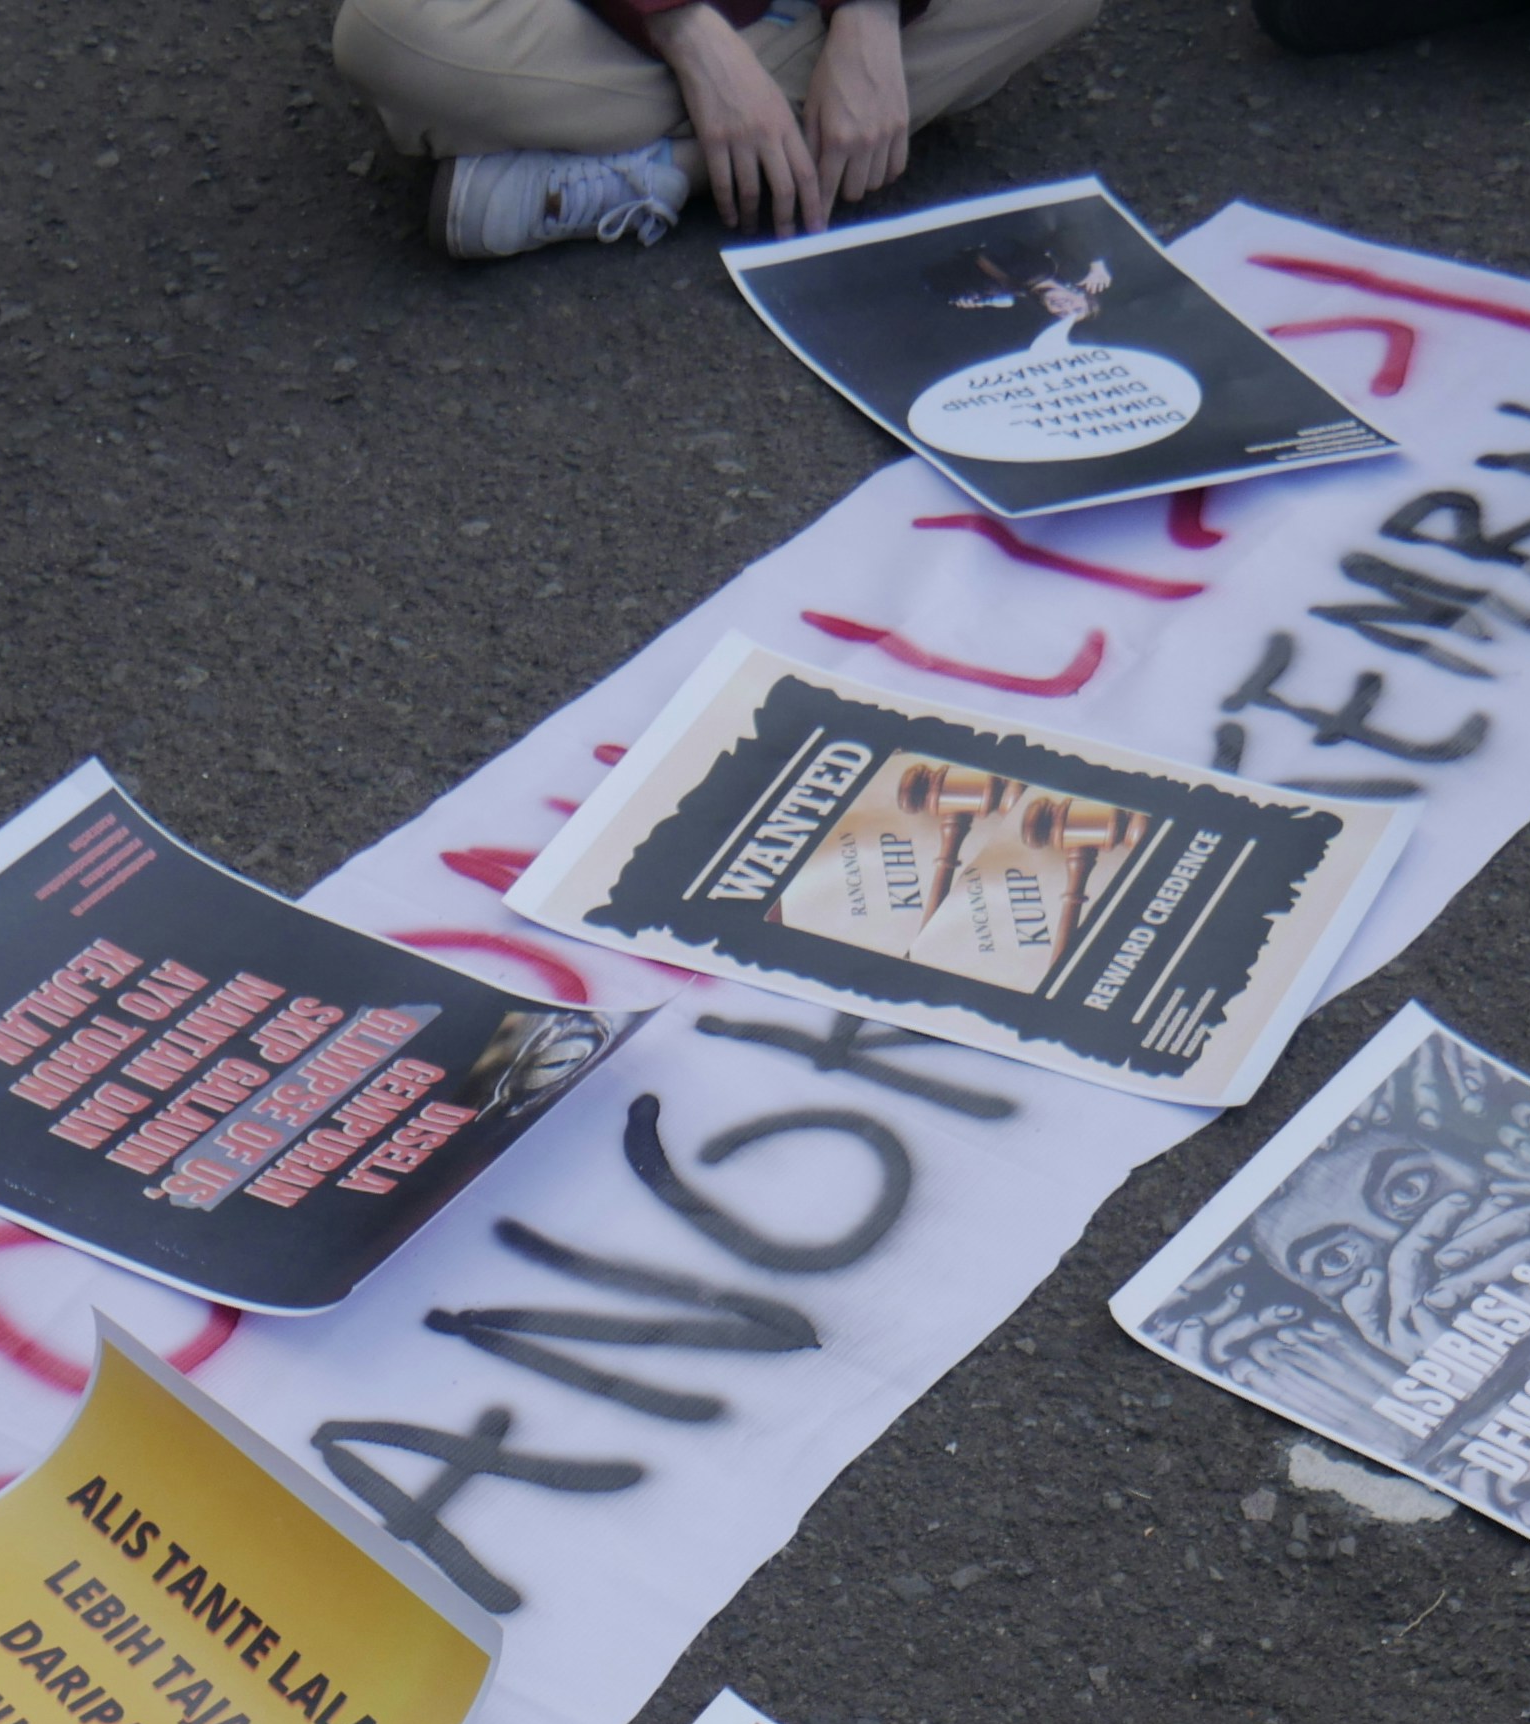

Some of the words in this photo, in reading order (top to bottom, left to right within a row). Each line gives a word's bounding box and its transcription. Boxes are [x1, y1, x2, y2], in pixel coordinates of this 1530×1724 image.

[938, 384, 1037, 414] RKUHP
[965, 347, 1114, 391] DIMANA???
[1038, 364, 1133, 394] DRAFT
[706, 740, 873, 900] WANTED
[837, 830, 869, 916] RANCANGAN
[879, 829, 925, 911] KUHP
[1004, 865, 1053, 947] KUHP
[1082, 925, 1156, 1011] REWARD
[1141, 829, 1222, 925] CREDENCE
[121, 960, 209, 1022] AYO
[126, 973, 287, 1092] MANTAN
[253, 996, 346, 1065] SKIP
[14, 1015, 148, 1110] TURUN
[248, 1006, 423, 1132] GLIMPSE
[55, 1082, 153, 1150] DAN
[108, 1056, 272, 1175] GALAUIN
[205, 1117, 289, 1169] OF
[249, 1058, 447, 1208] GEMPURAN
[340, 1101, 479, 1195] DISELA
[42, 1558, 166, 1667] LEBIH
[65, 1474, 161, 1559] ALIS
[151, 1540, 281, 1669] TANTE
